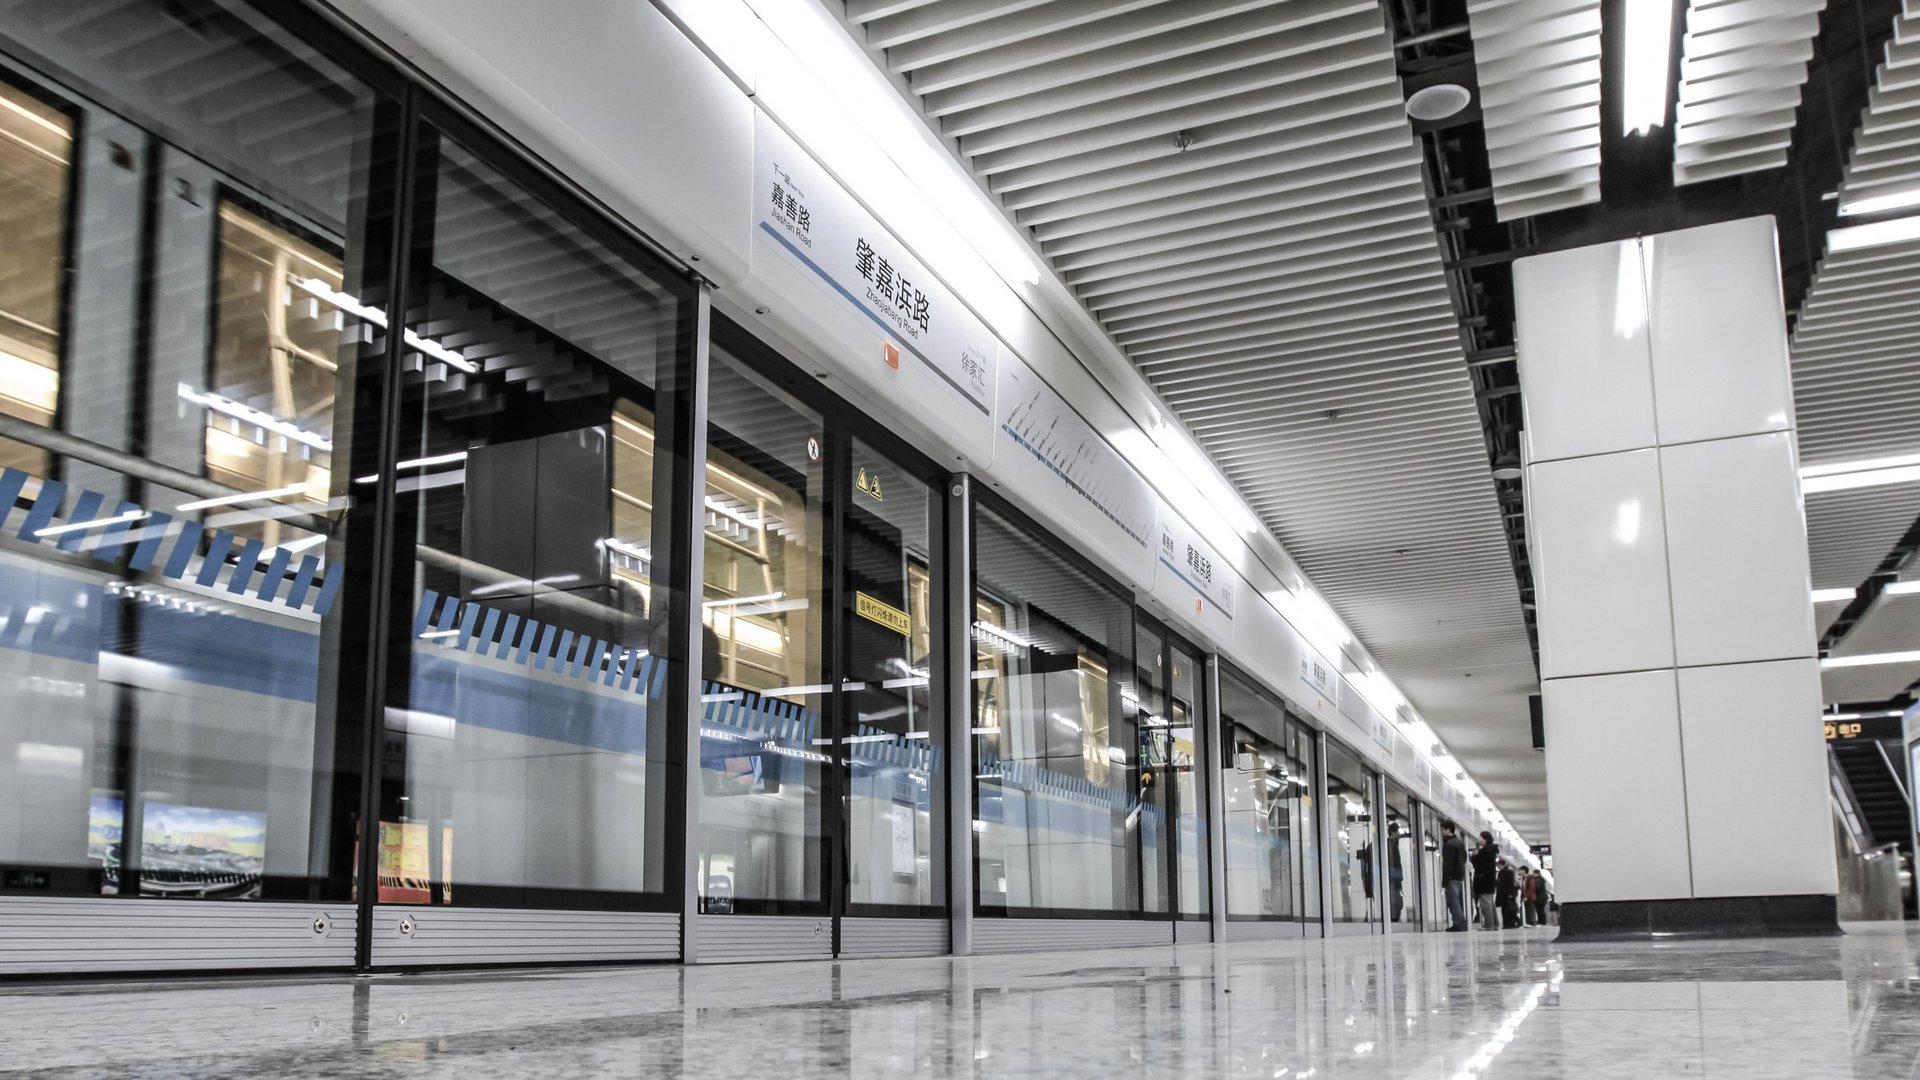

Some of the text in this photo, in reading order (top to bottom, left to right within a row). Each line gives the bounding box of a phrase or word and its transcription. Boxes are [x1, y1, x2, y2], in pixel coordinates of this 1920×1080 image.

[773, 161, 790, 185] 下一站
[770, 206, 812, 248] Jiashan Road
[771, 181, 811, 233] 嘉善路
[855, 236, 930, 334] 肇嘉浜路
[865, 286, 919, 340] Zhaojiabang Road
